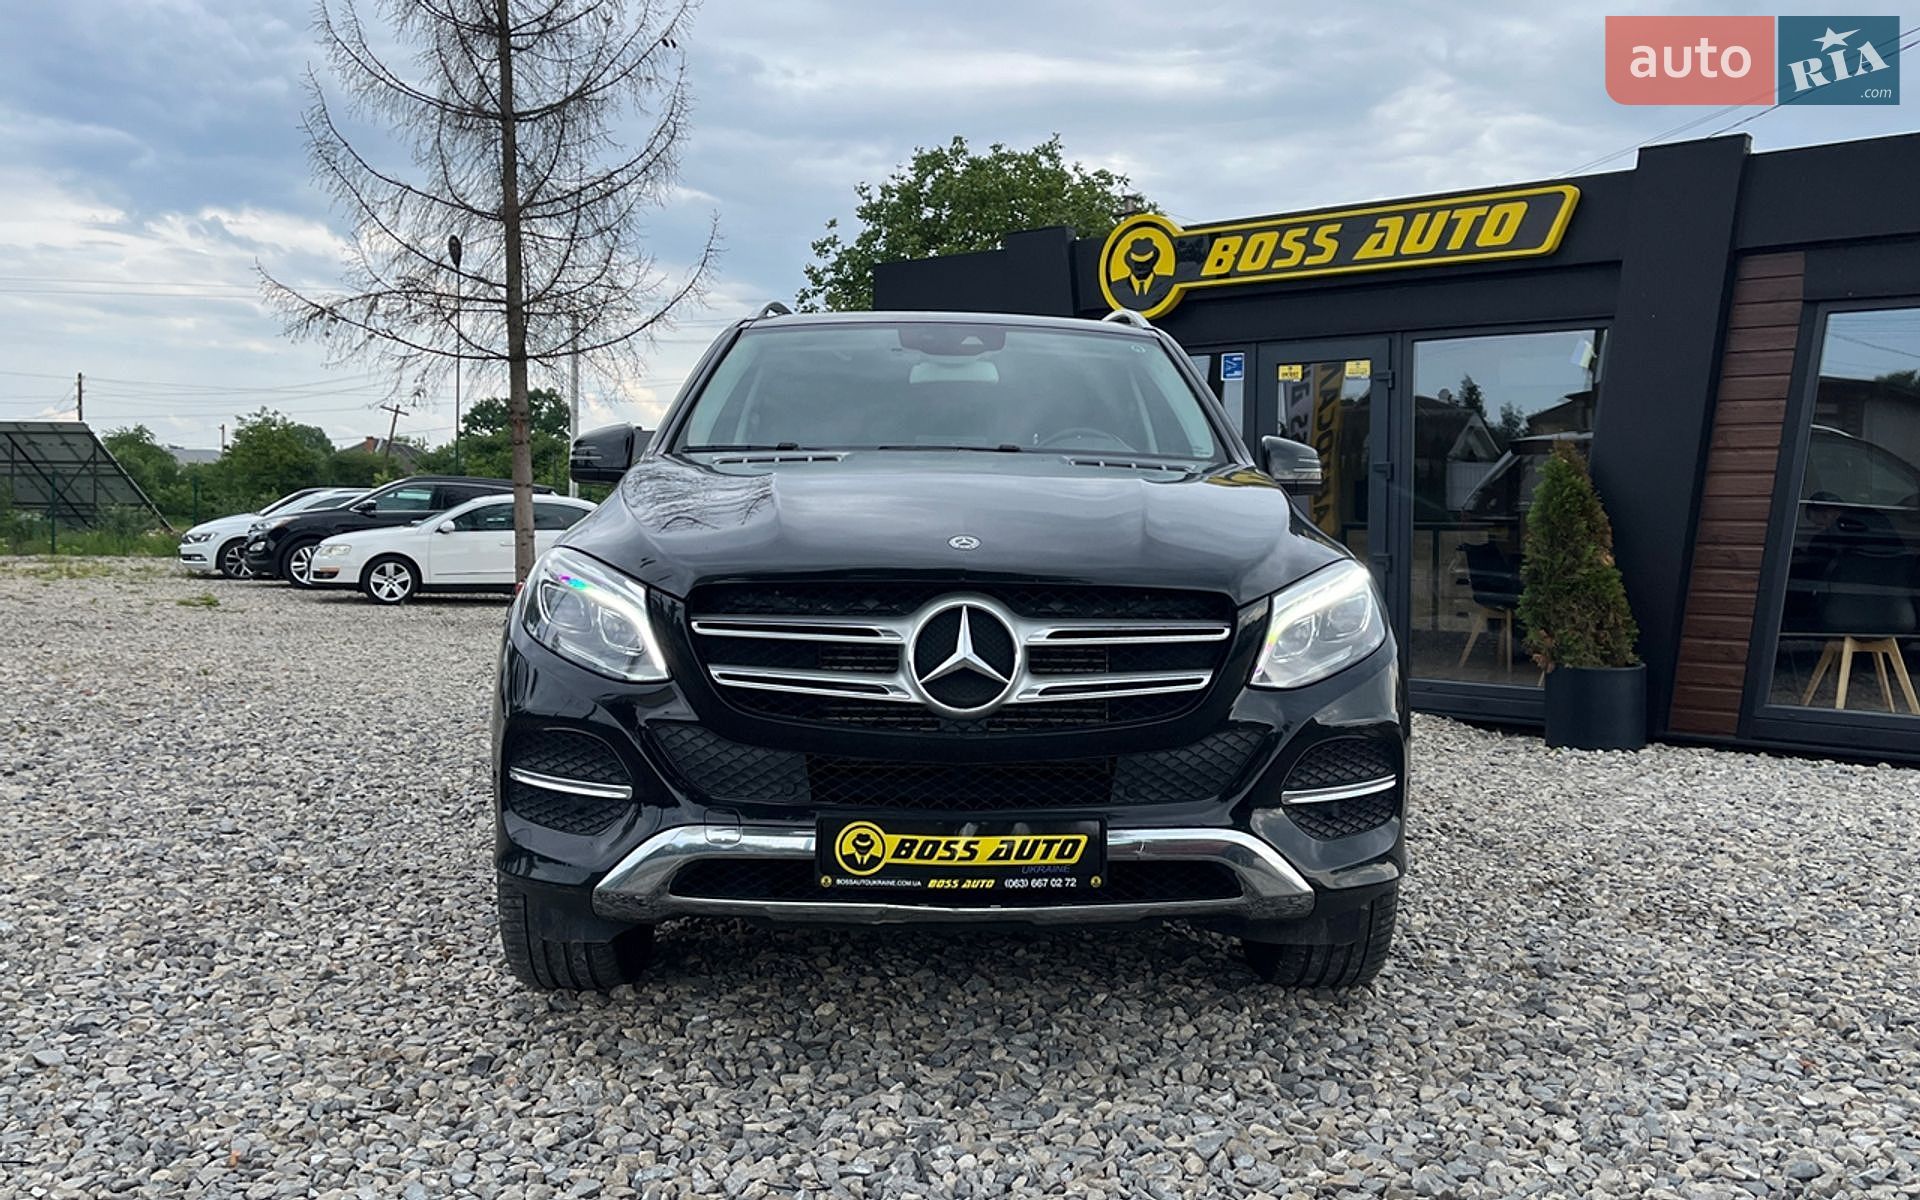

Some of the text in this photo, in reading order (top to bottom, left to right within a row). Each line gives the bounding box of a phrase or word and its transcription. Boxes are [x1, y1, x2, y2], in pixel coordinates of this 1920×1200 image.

[1200, 201, 1528, 276] BOSS AUTO
[890, 838, 1082, 861] BOSS AUTO
[1021, 865, 1071, 874] UKRAINE
[927, 879, 995, 888] BOSS AUTO
[1004, 878, 1077, 888] (063) 667 02 72
